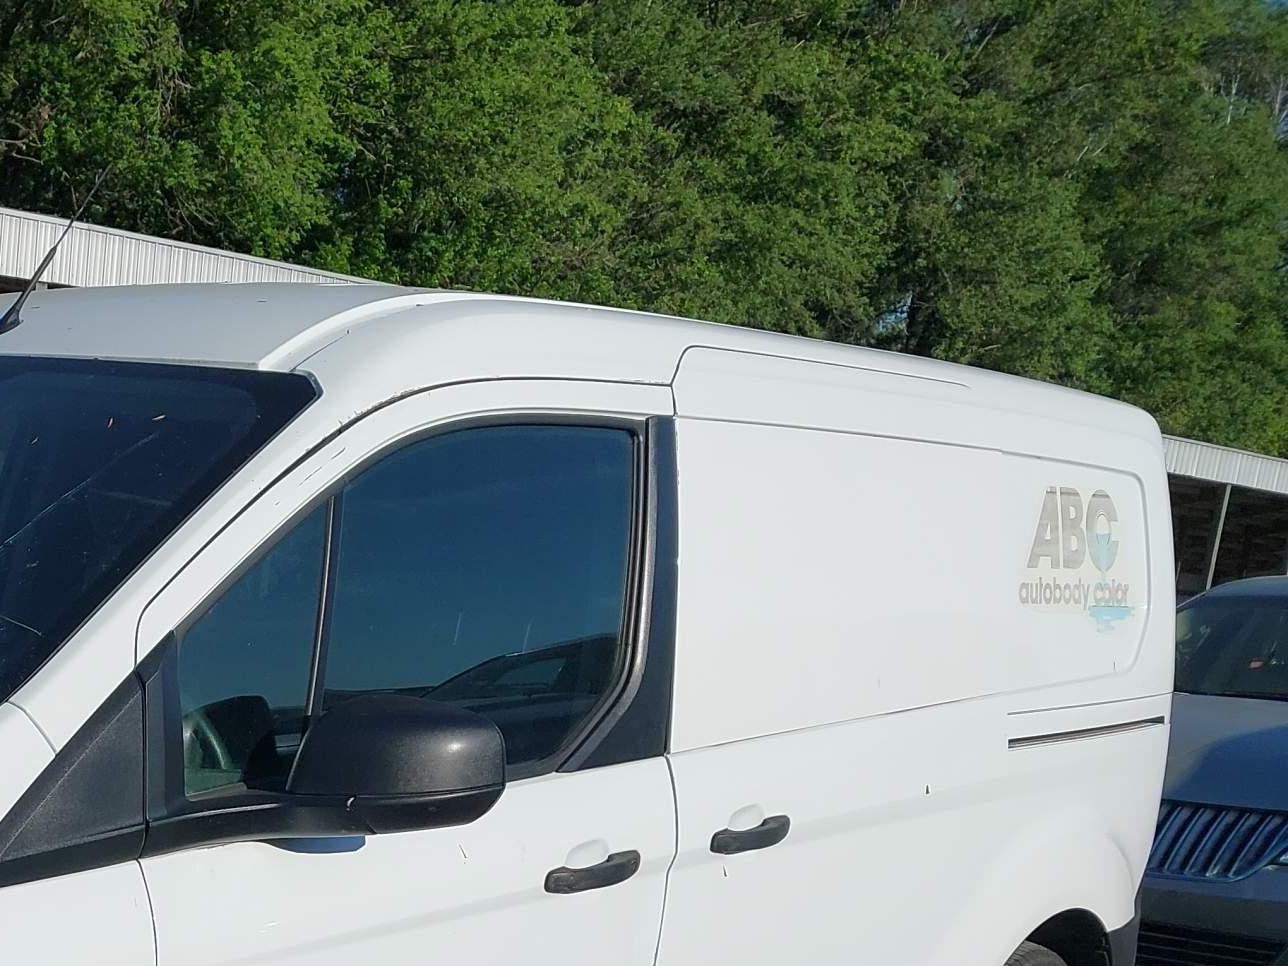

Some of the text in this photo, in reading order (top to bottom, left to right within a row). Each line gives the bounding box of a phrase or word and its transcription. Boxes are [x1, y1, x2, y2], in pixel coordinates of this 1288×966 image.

[1026, 486, 1120, 572] ABC
[1018, 577, 1129, 611] autobody color
